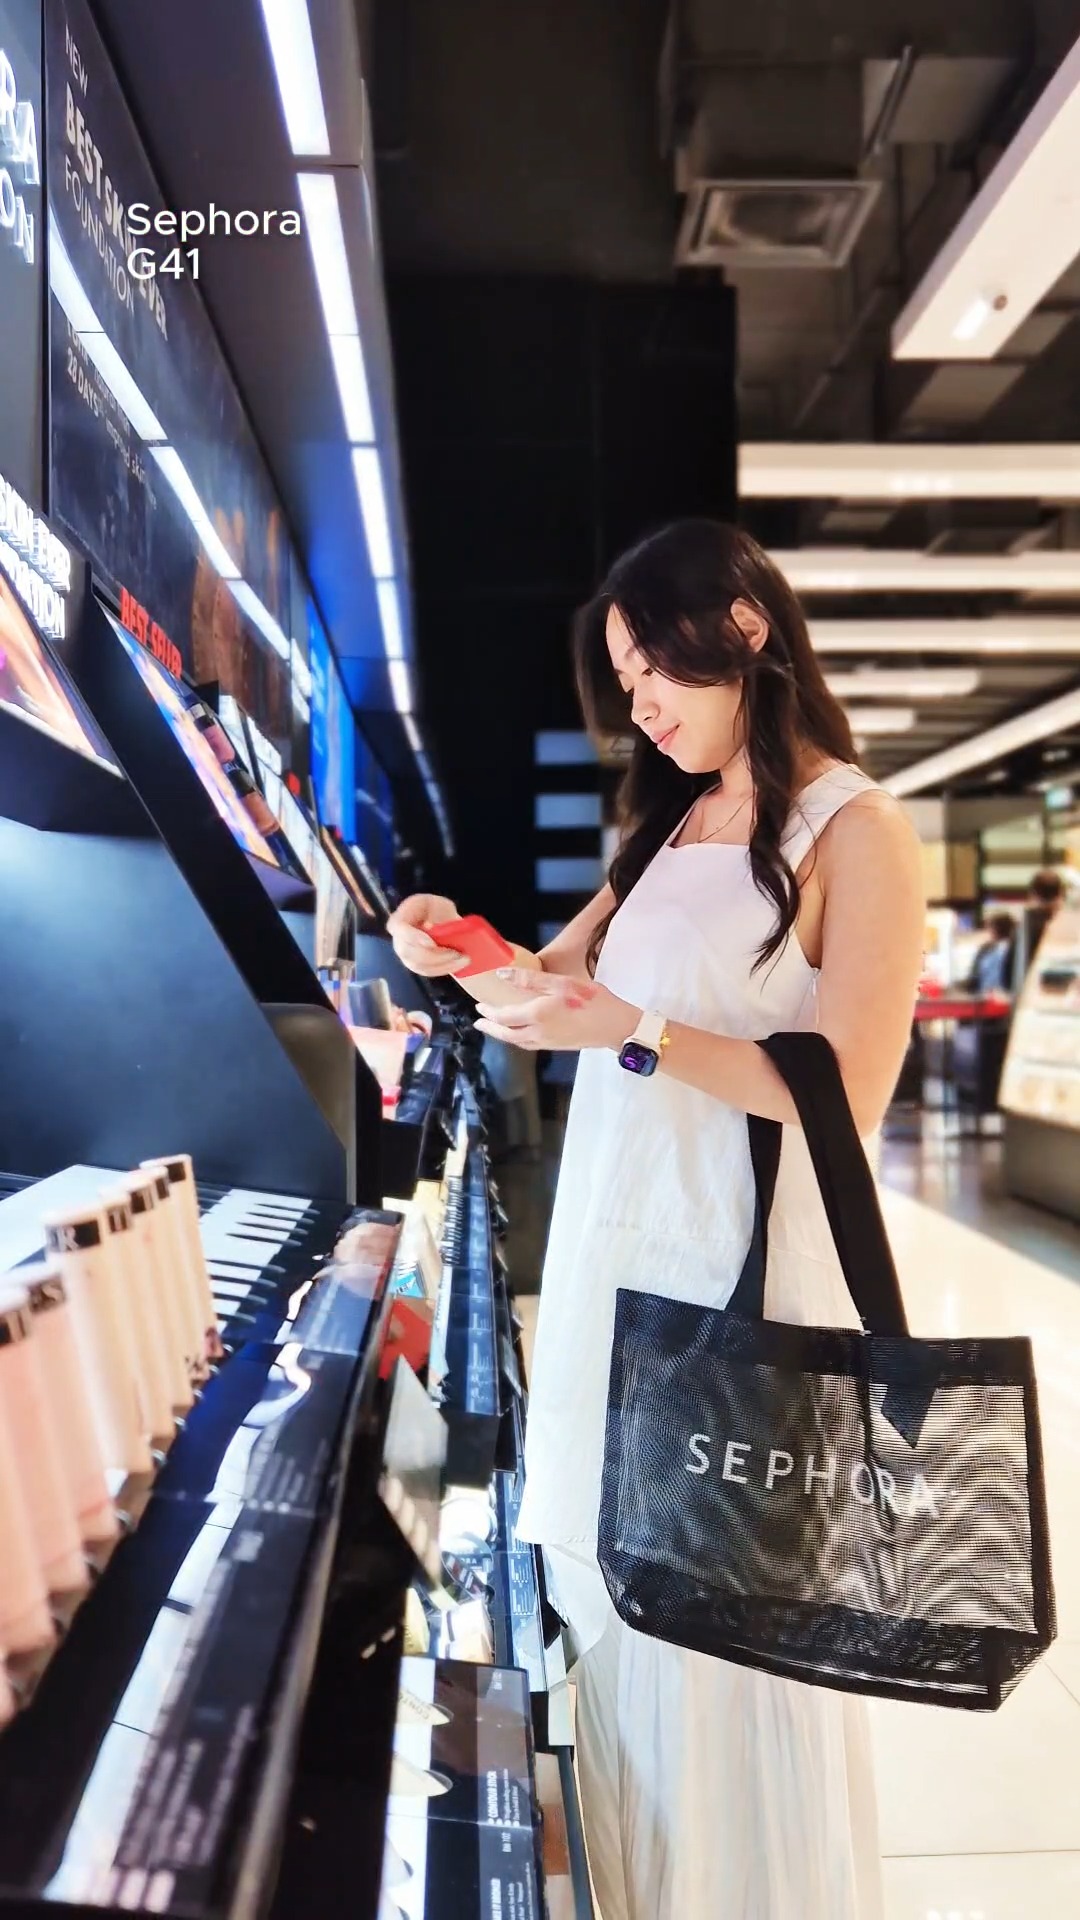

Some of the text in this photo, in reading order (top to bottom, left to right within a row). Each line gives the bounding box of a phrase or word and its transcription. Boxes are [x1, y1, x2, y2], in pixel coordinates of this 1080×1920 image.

[66, 23, 88, 97] NEW
[66, 81, 104, 200] BEST
[65, 154, 134, 318] FOUNDATION
[67, 347, 79, 384] 28
[78, 370, 100, 418] DAYS
[120, 586, 182, 680] BEST SELLER
[685, 1433, 940, 1519] SEPHORA
